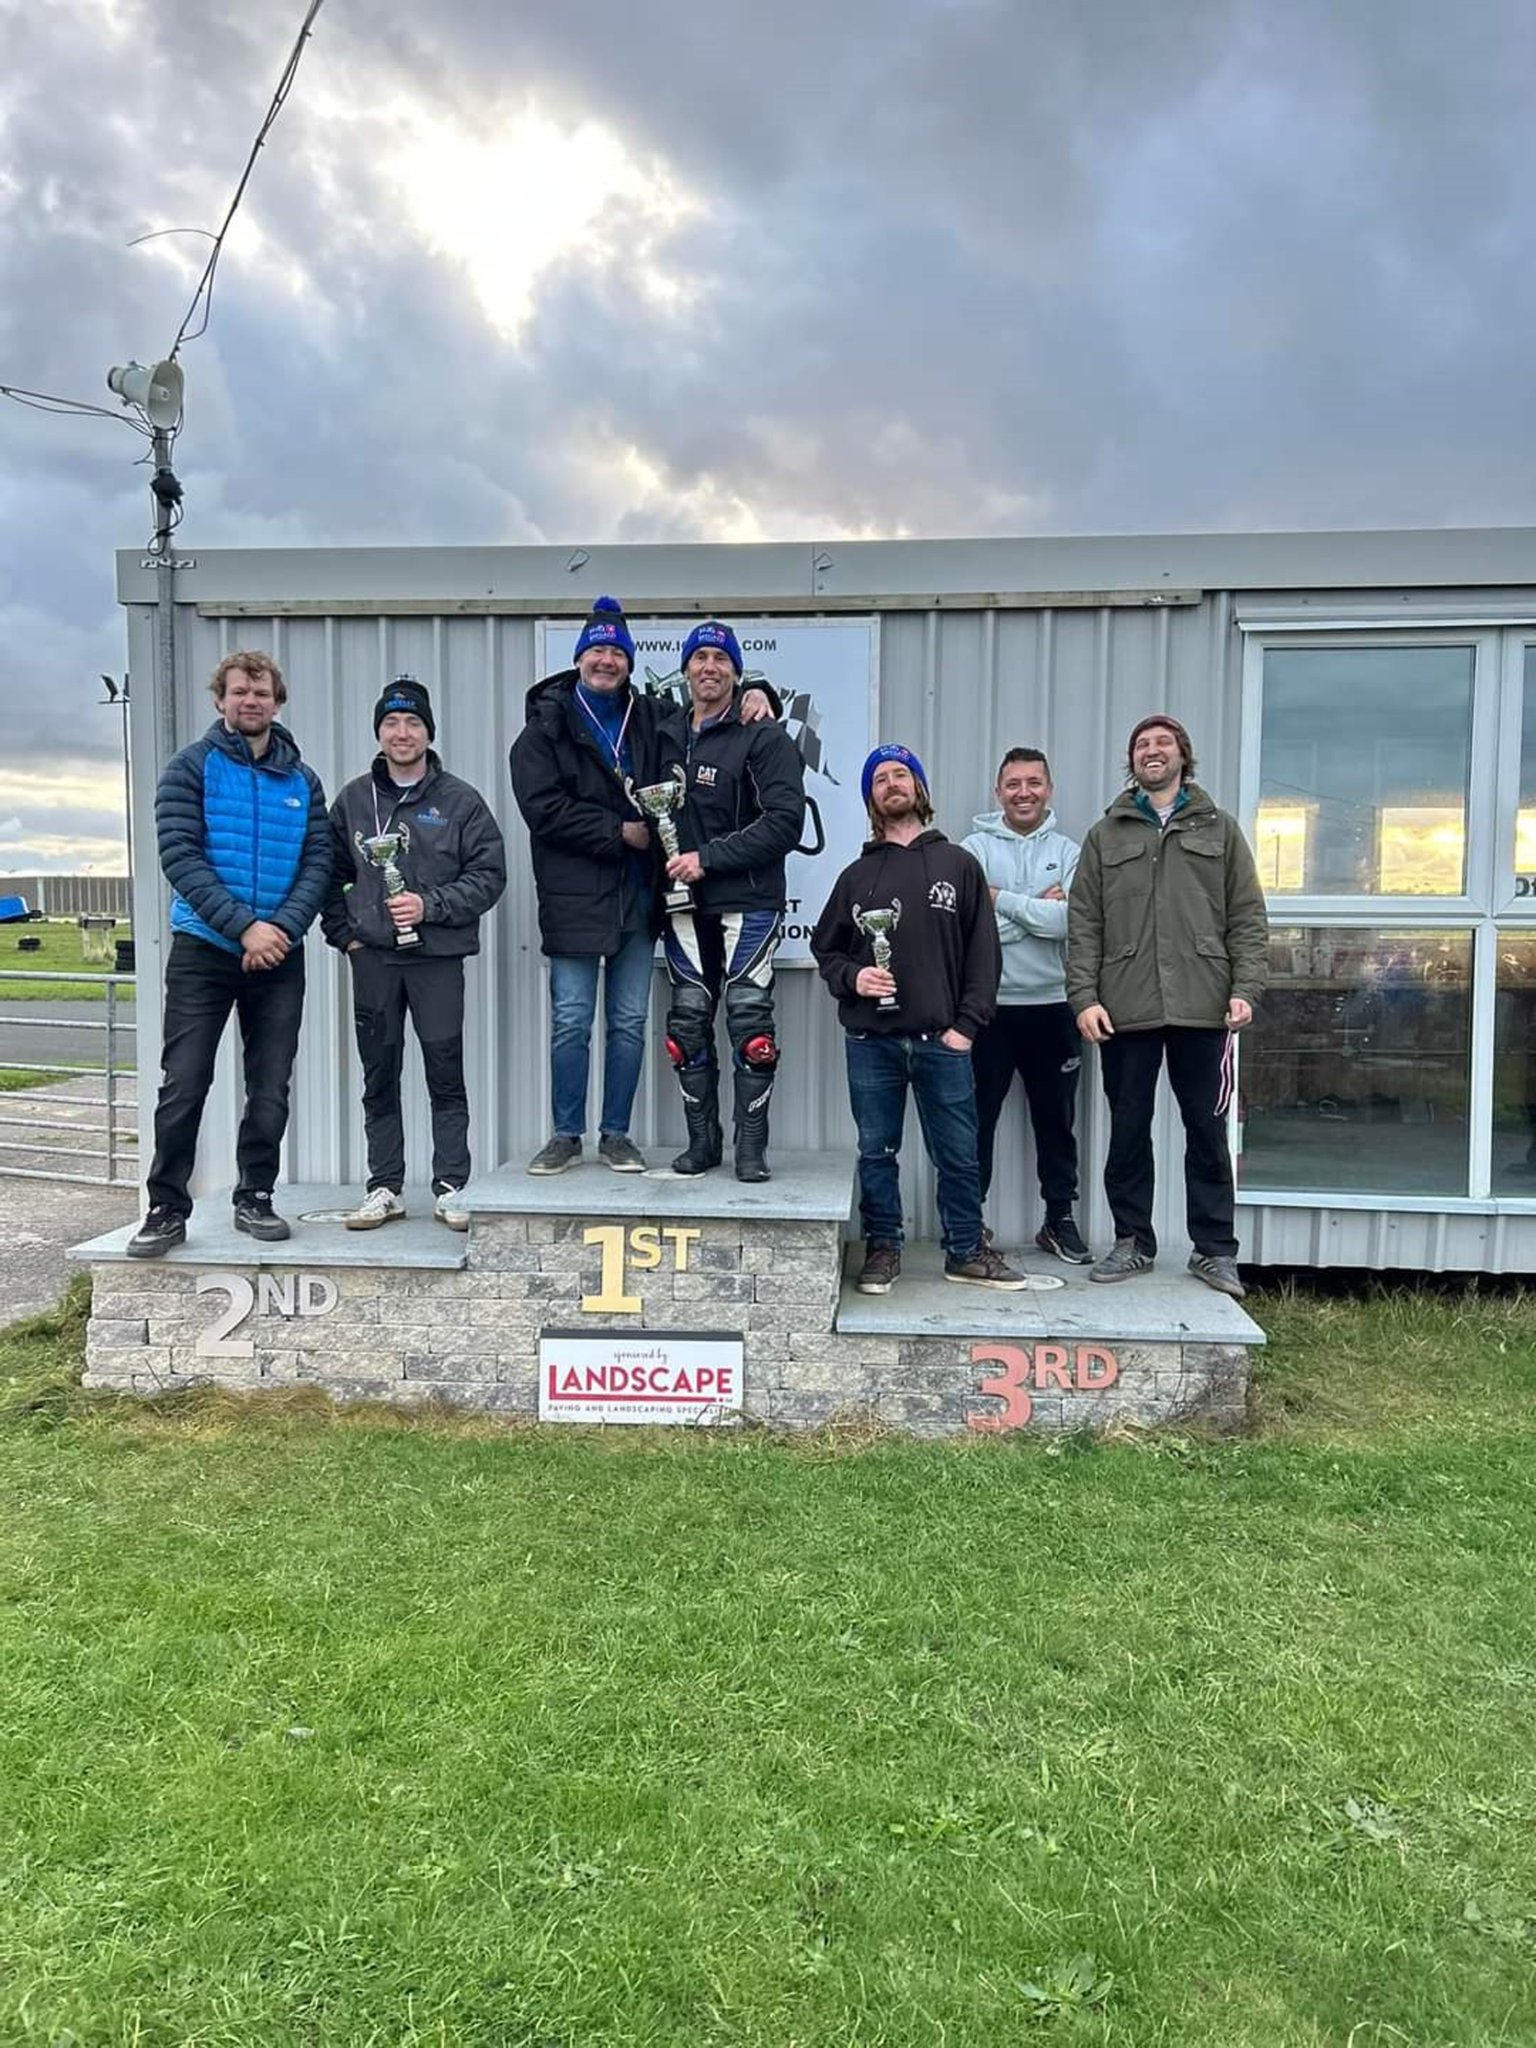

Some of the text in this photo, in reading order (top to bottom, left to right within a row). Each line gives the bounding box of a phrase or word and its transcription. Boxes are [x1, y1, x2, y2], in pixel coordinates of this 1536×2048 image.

[698, 765, 717, 781] CAT
[582, 1226, 701, 1313] 1ST
[196, 1273, 338, 1357] 2ND
[614, 1347, 668, 1365] sponsored by
[549, 1365, 733, 1402] LANDSCAPE
[967, 1344, 1118, 1433] 3RD
[585, 1404, 604, 1412] AND
[607, 1405, 673, 1414] LANDSCAPING
